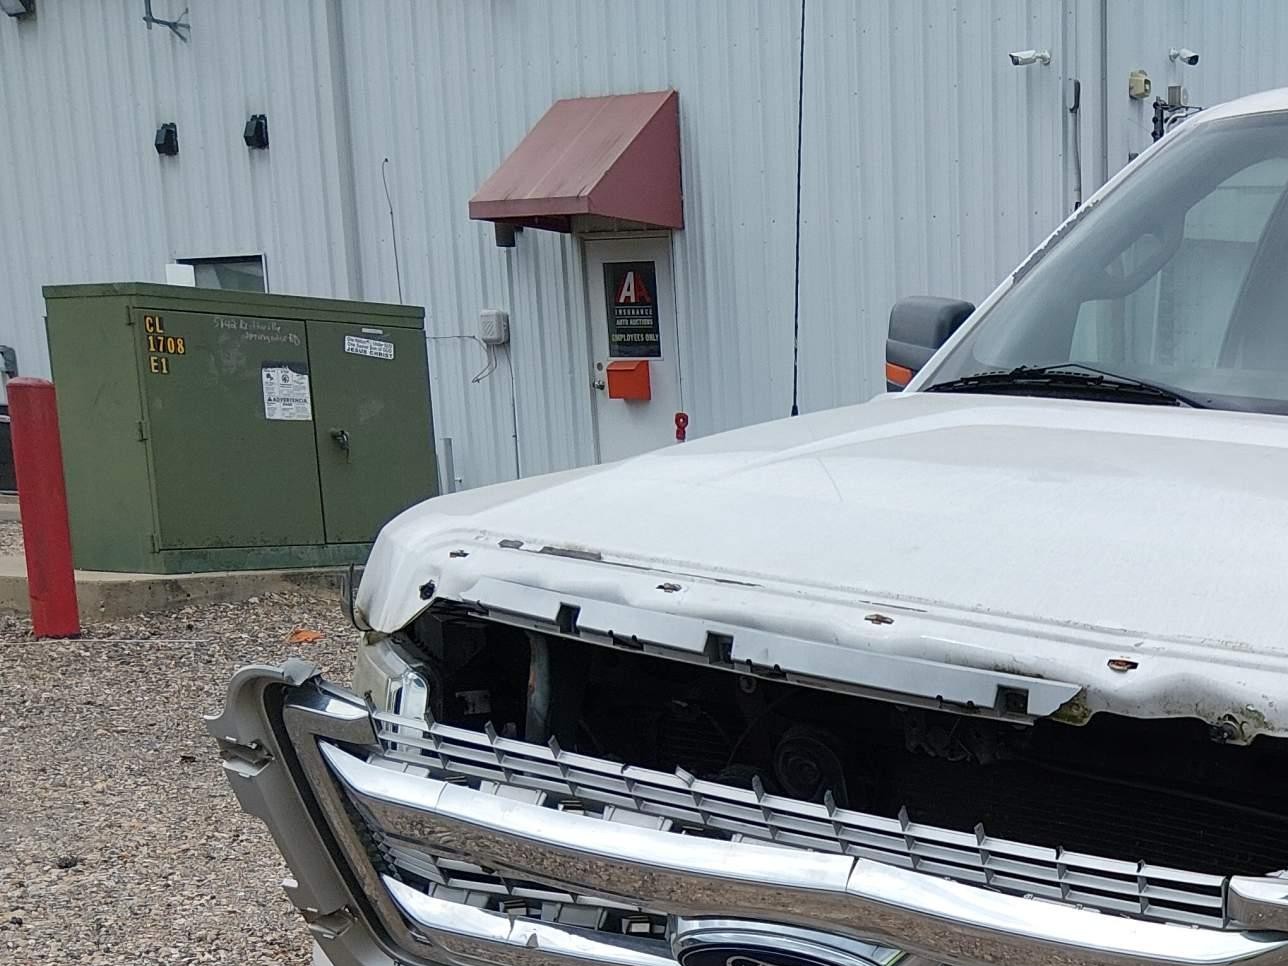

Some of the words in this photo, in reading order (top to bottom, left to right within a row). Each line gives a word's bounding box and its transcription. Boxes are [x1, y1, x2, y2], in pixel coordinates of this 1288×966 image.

[145, 316, 164, 333] CL
[148, 336, 185, 354] 1708
[611, 333, 644, 342] EMPLOYEES
[645, 333, 659, 342] ONLY
[347, 346, 367, 354] JESUS
[370, 350, 393, 358] CHRIST
[151, 356, 168, 373] E1
